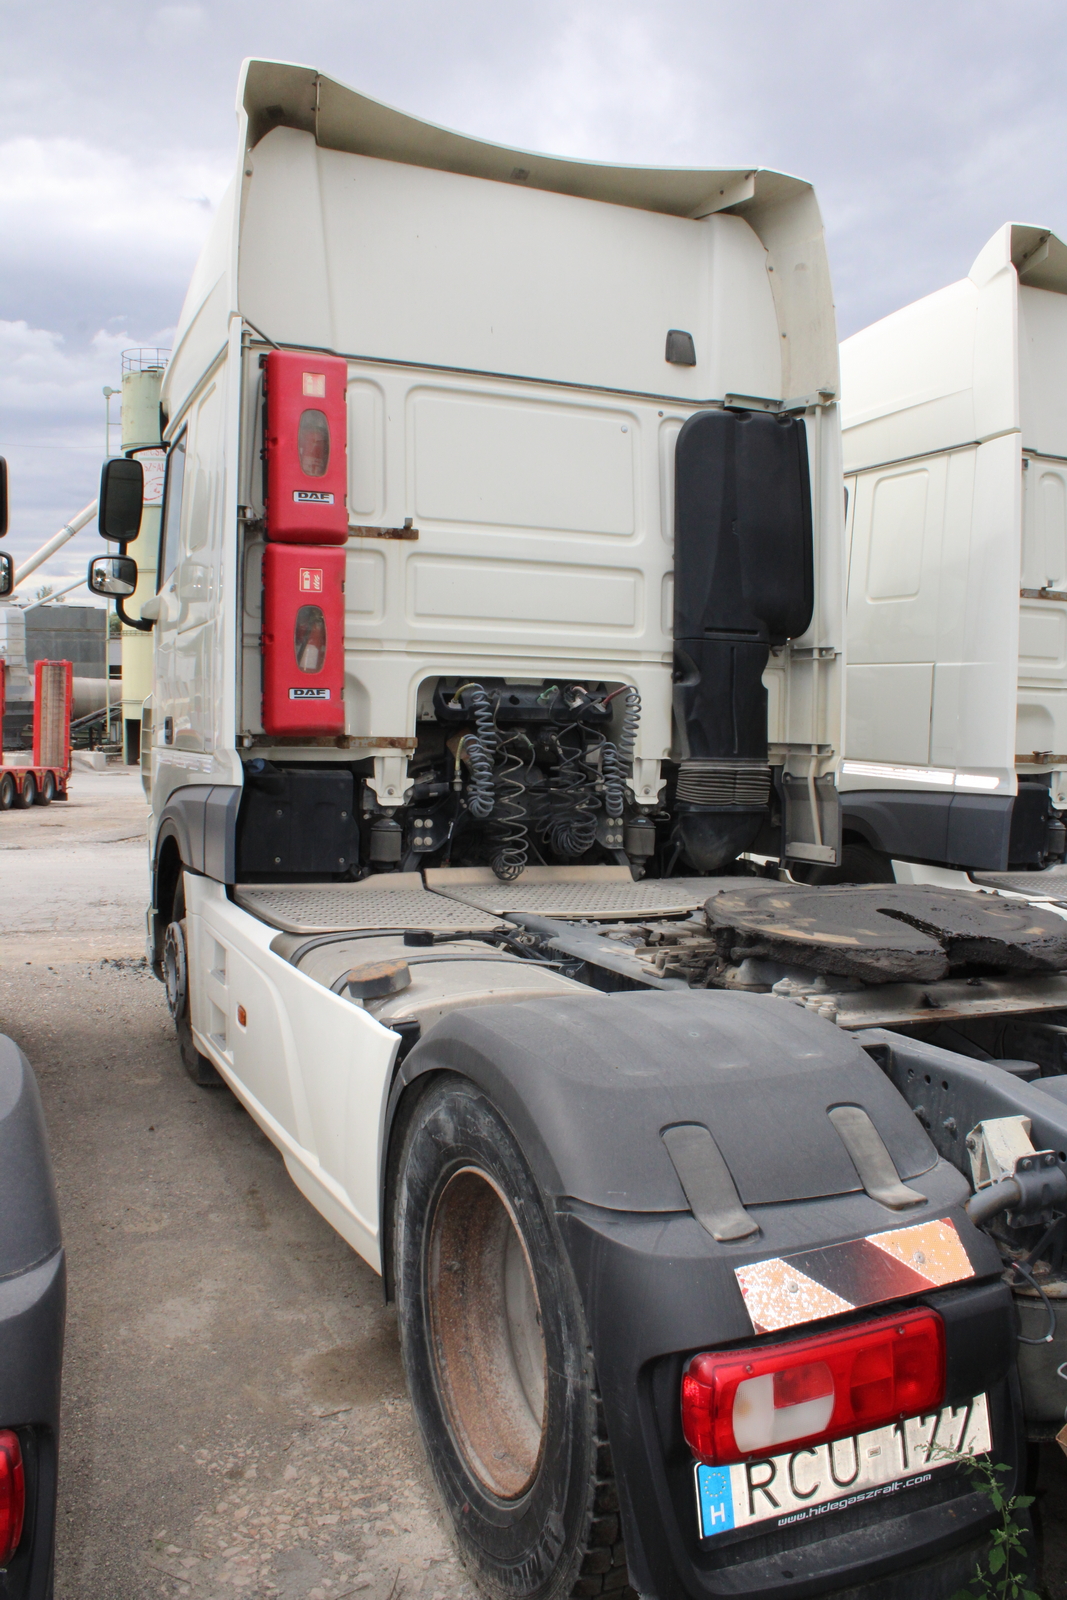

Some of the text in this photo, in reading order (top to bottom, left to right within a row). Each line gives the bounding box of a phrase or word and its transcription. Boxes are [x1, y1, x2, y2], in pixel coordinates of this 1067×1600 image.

[298, 492, 331, 500] DAF
[743, 1402, 973, 1517] RCU-177
[710, 1502, 726, 1527] H
[777, 1473, 932, 1527] www.hidegaszfalt.com
